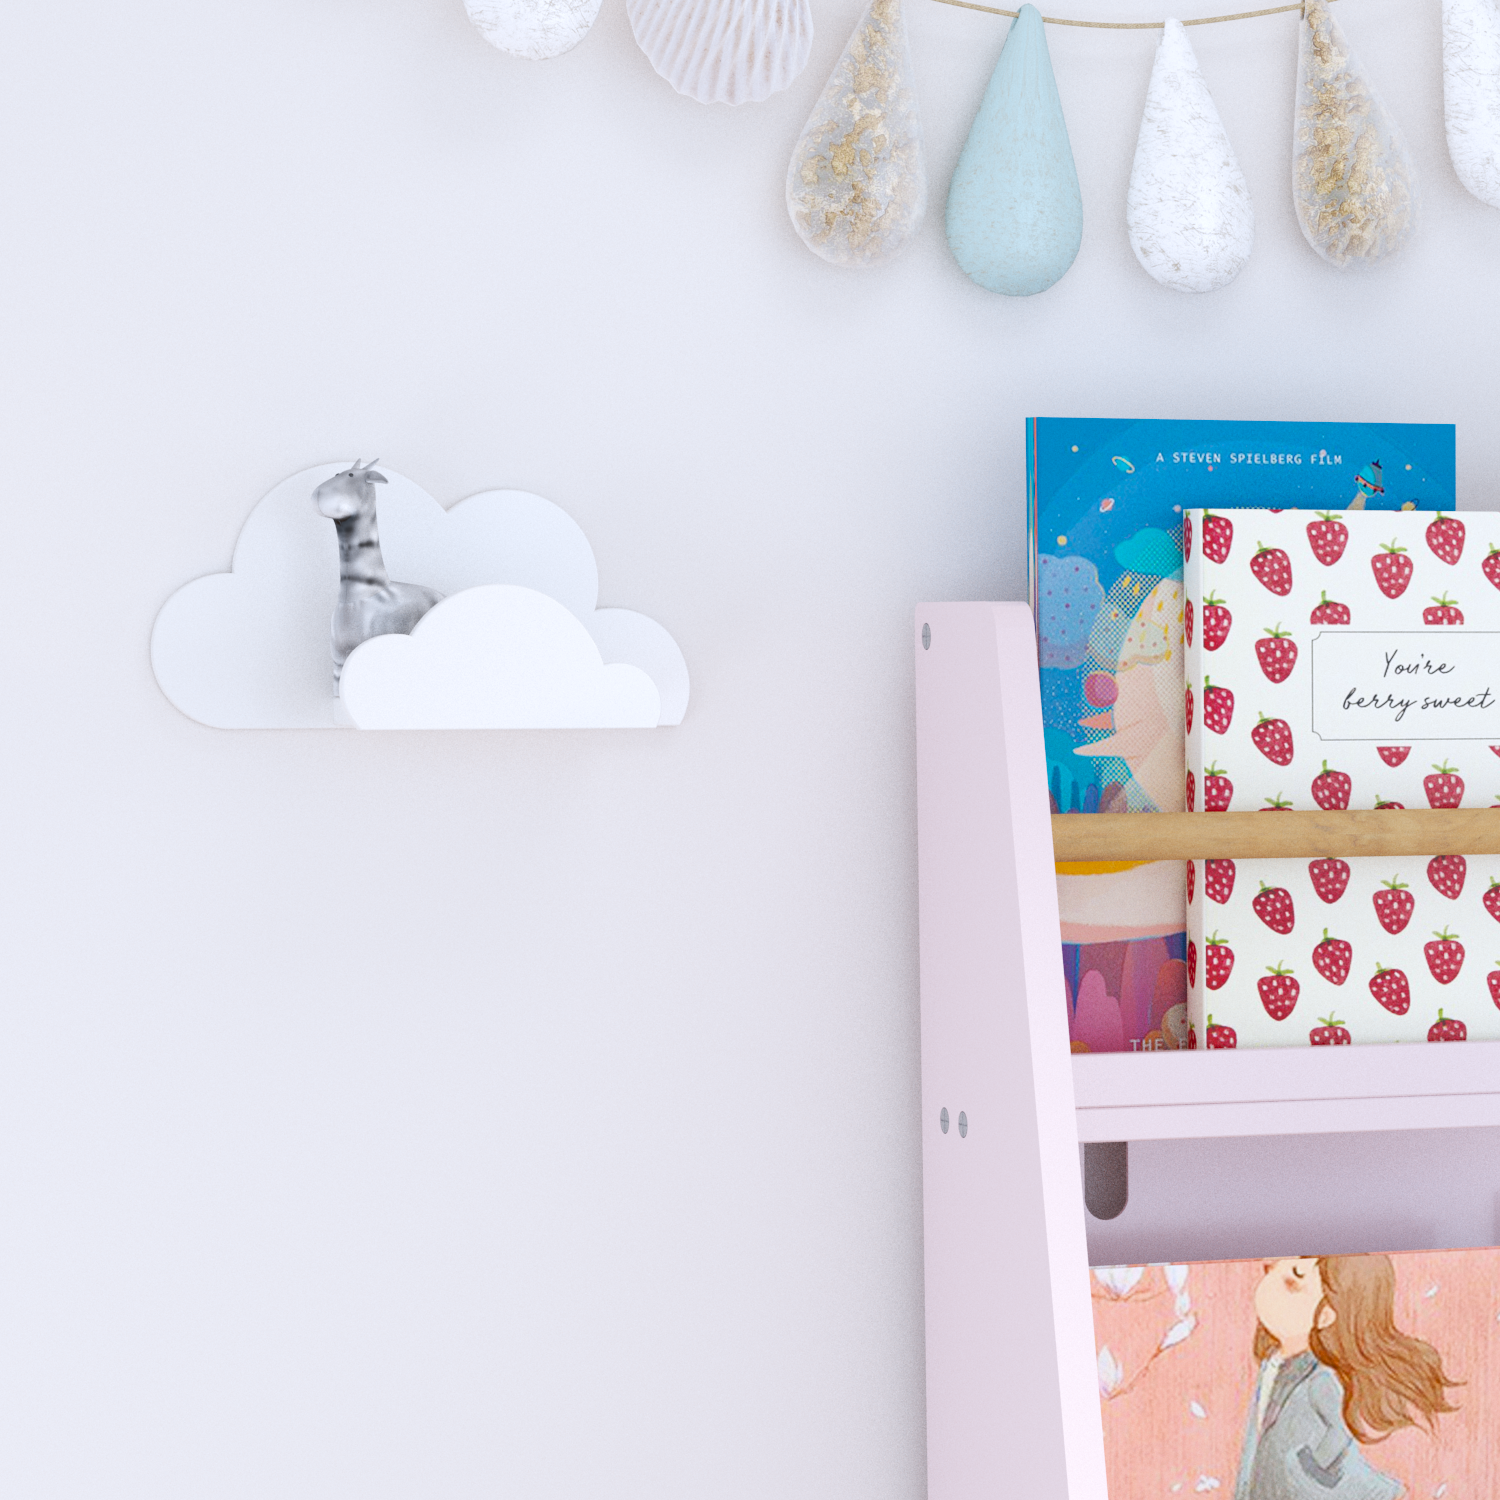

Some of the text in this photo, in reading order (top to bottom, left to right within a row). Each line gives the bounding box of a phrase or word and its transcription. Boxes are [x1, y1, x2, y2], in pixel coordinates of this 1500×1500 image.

[1155, 452, 1342, 465] A STEVEN SPIELBERG FILM
[1383, 649, 1455, 678] You're
[1342, 687, 1496, 722] berry sweet
[1129, 1039, 1164, 1052] THE
